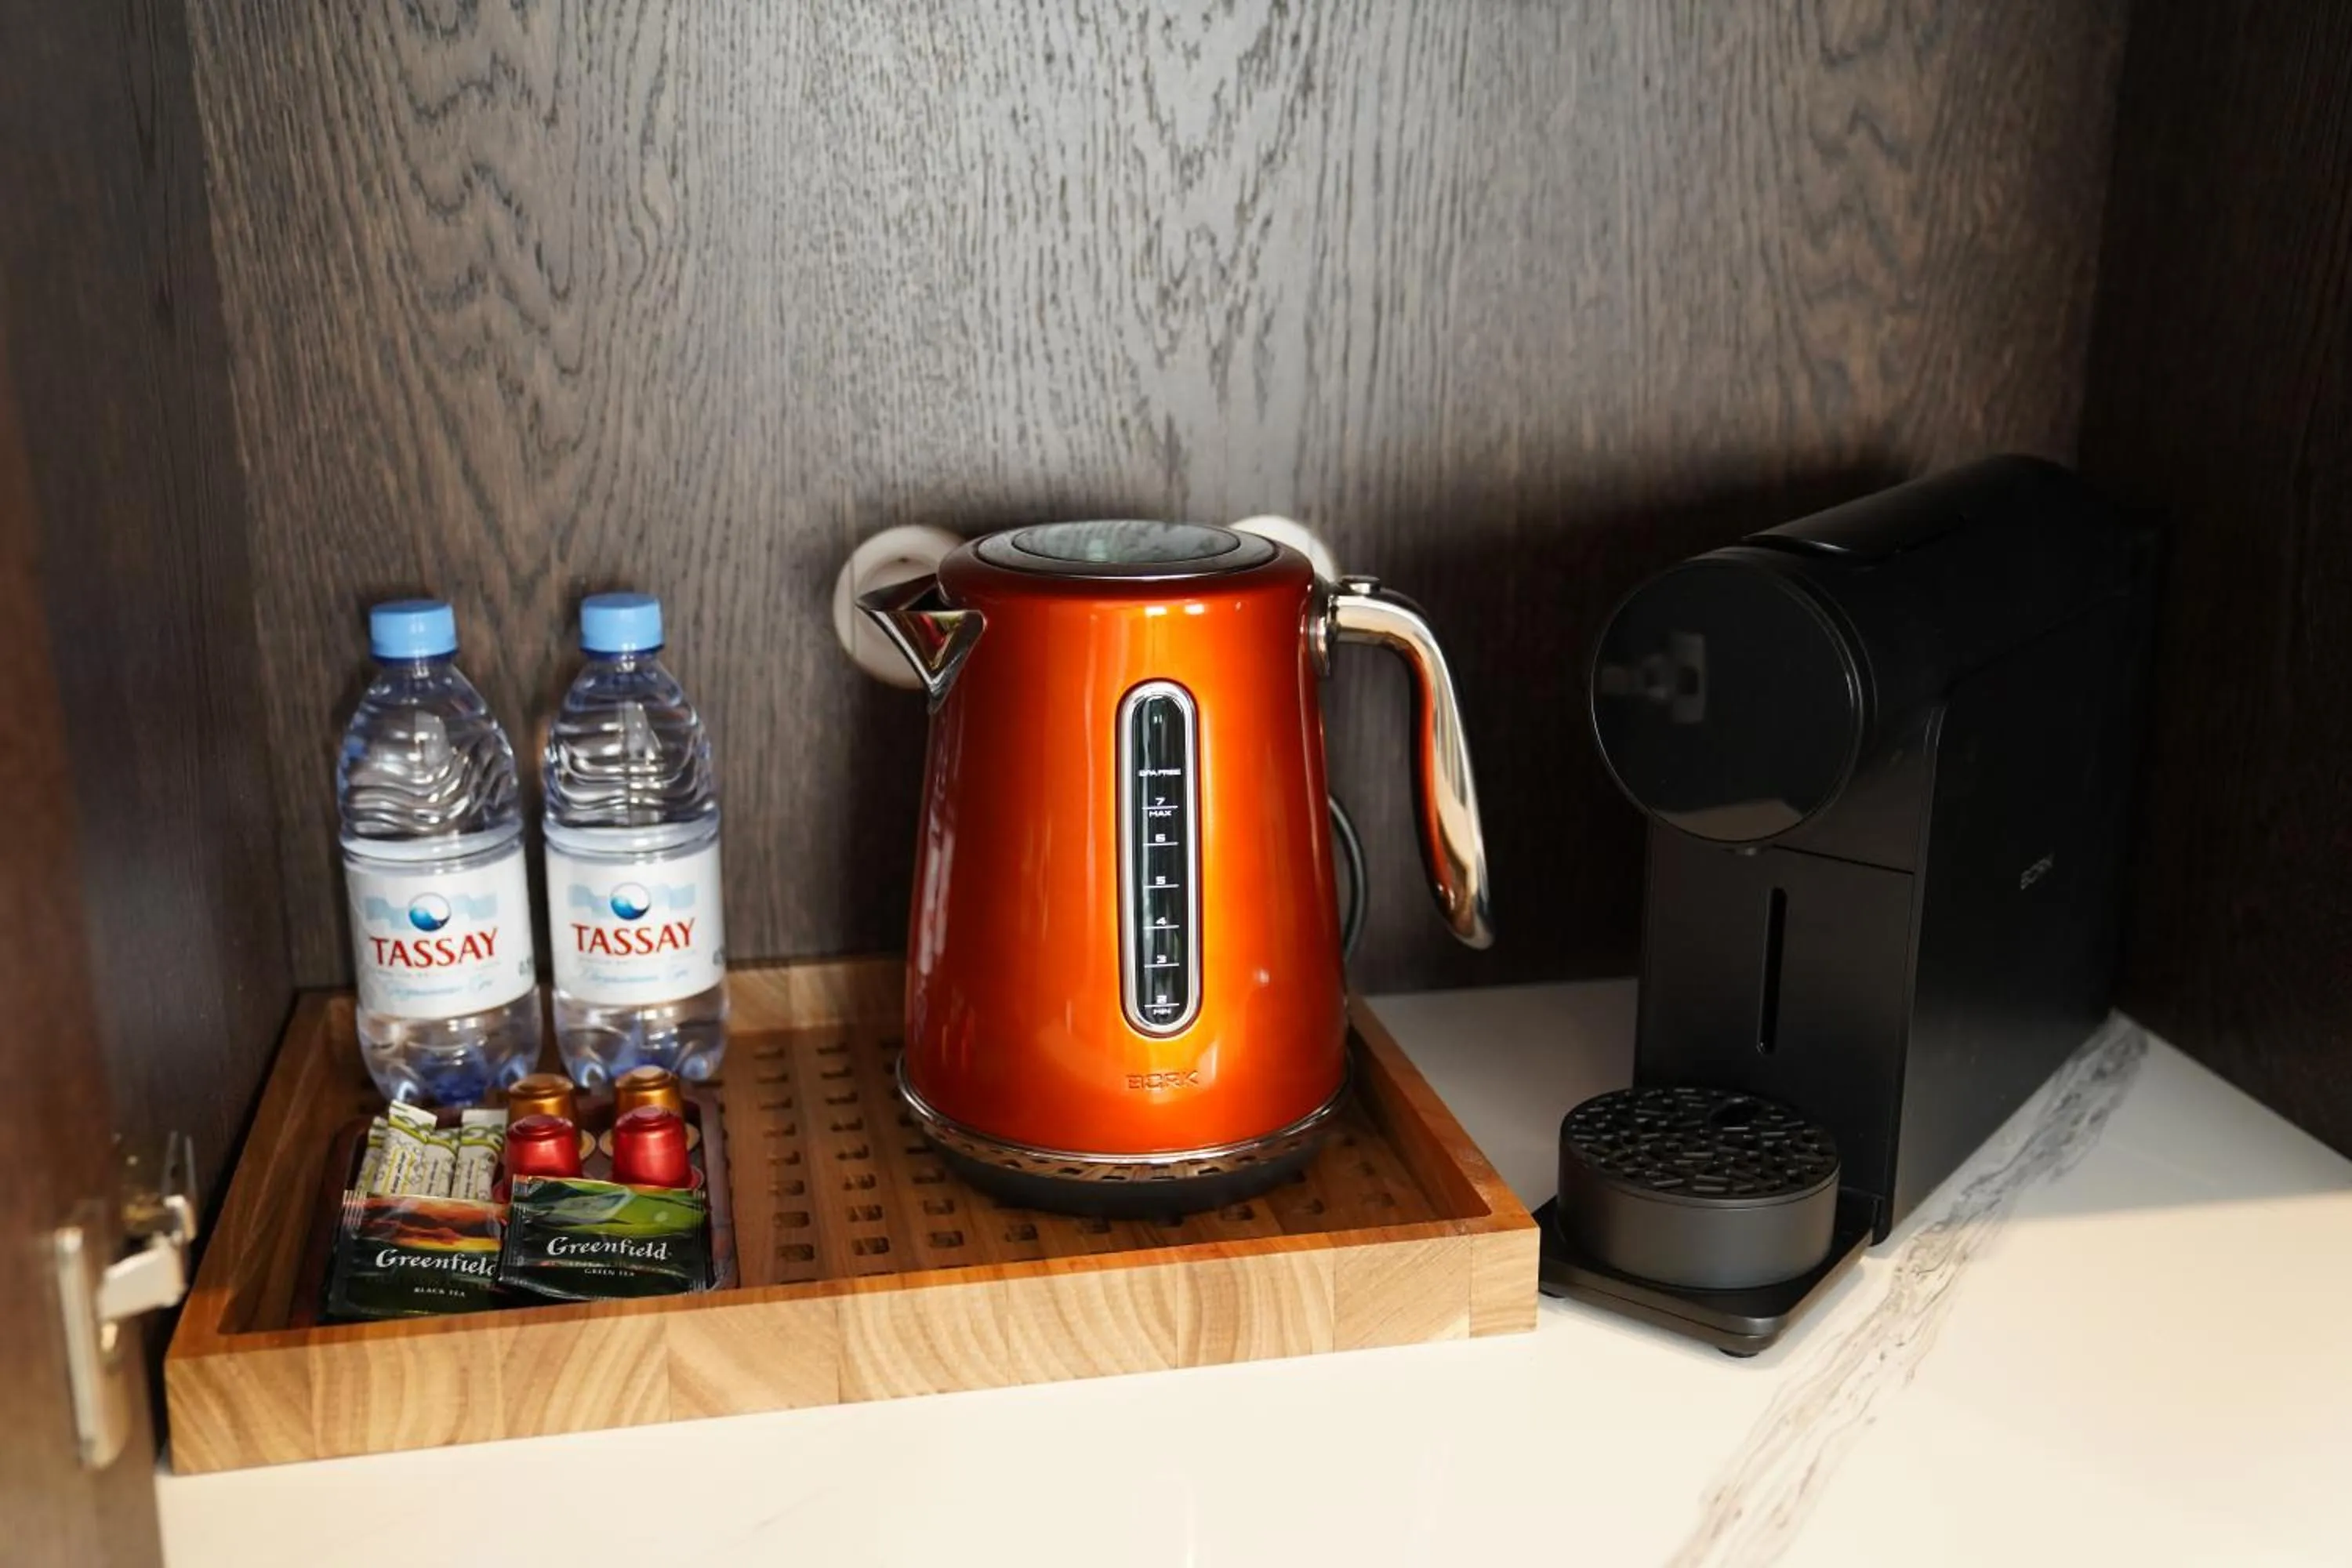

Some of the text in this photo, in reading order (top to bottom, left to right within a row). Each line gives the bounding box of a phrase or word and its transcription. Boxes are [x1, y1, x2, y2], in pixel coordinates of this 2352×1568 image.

[1154, 797, 1167, 806] 7
[1155, 833, 1166, 842] 6
[1156, 876, 1167, 885] 5
[1156, 916, 1167, 926] 4
[571, 916, 696, 957] TASSAY
[368, 926, 499, 969] TASSAY
[1156, 955, 1167, 964] 3
[1156, 995, 1167, 1004] 2
[1126, 1070, 1200, 1089] BORK
[546, 1236, 668, 1261] Greenfield
[584, 1268, 636, 1277] GREEN TEA
[413, 1286, 466, 1298] BLACK TEA
